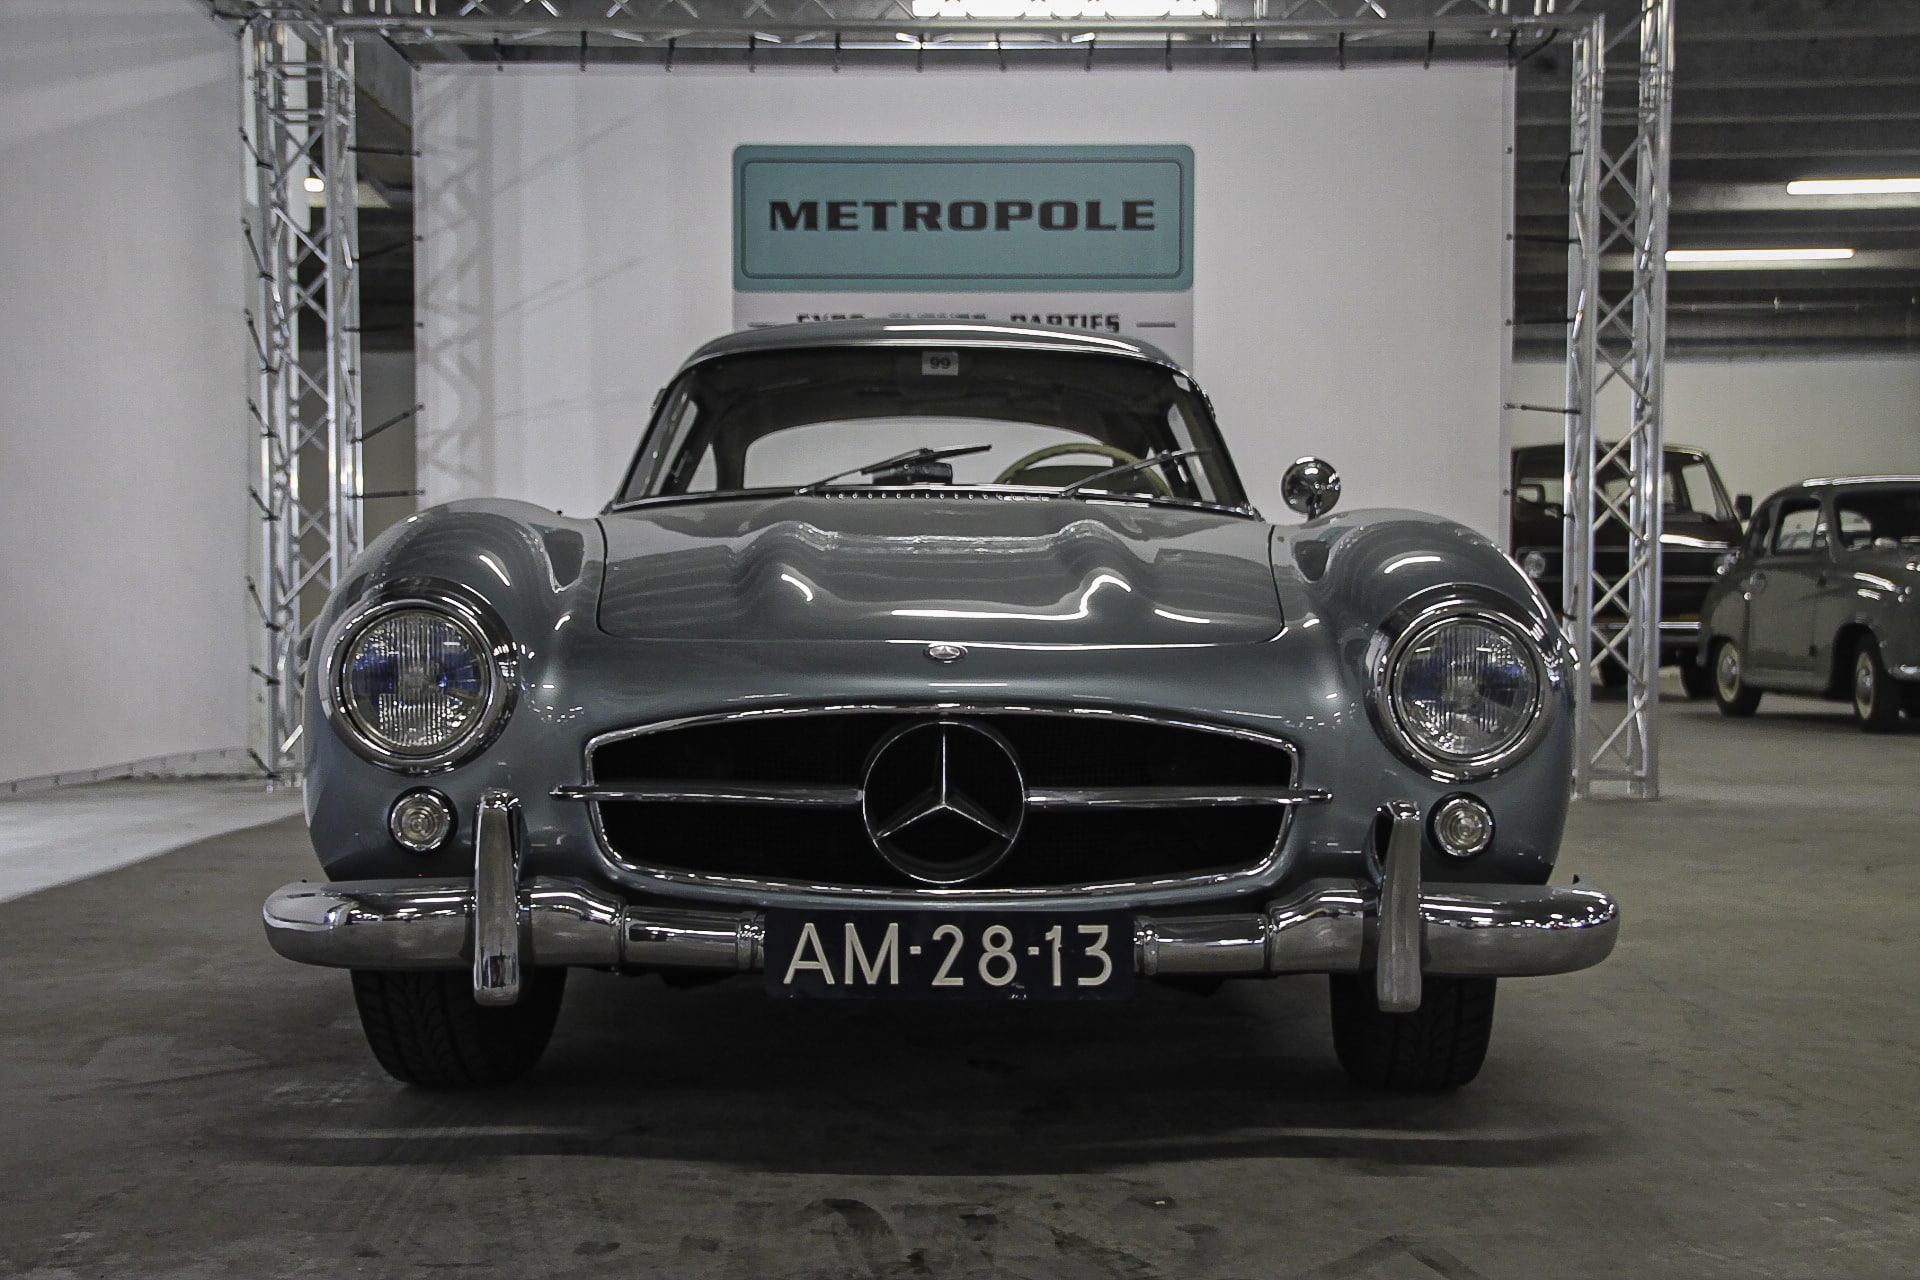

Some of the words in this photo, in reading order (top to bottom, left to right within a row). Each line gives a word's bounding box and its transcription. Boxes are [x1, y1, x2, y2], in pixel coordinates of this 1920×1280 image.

[769, 200, 1155, 231] METROPOLE
[929, 356, 951, 370] 99
[783, 922, 1113, 987] AM-28-13
